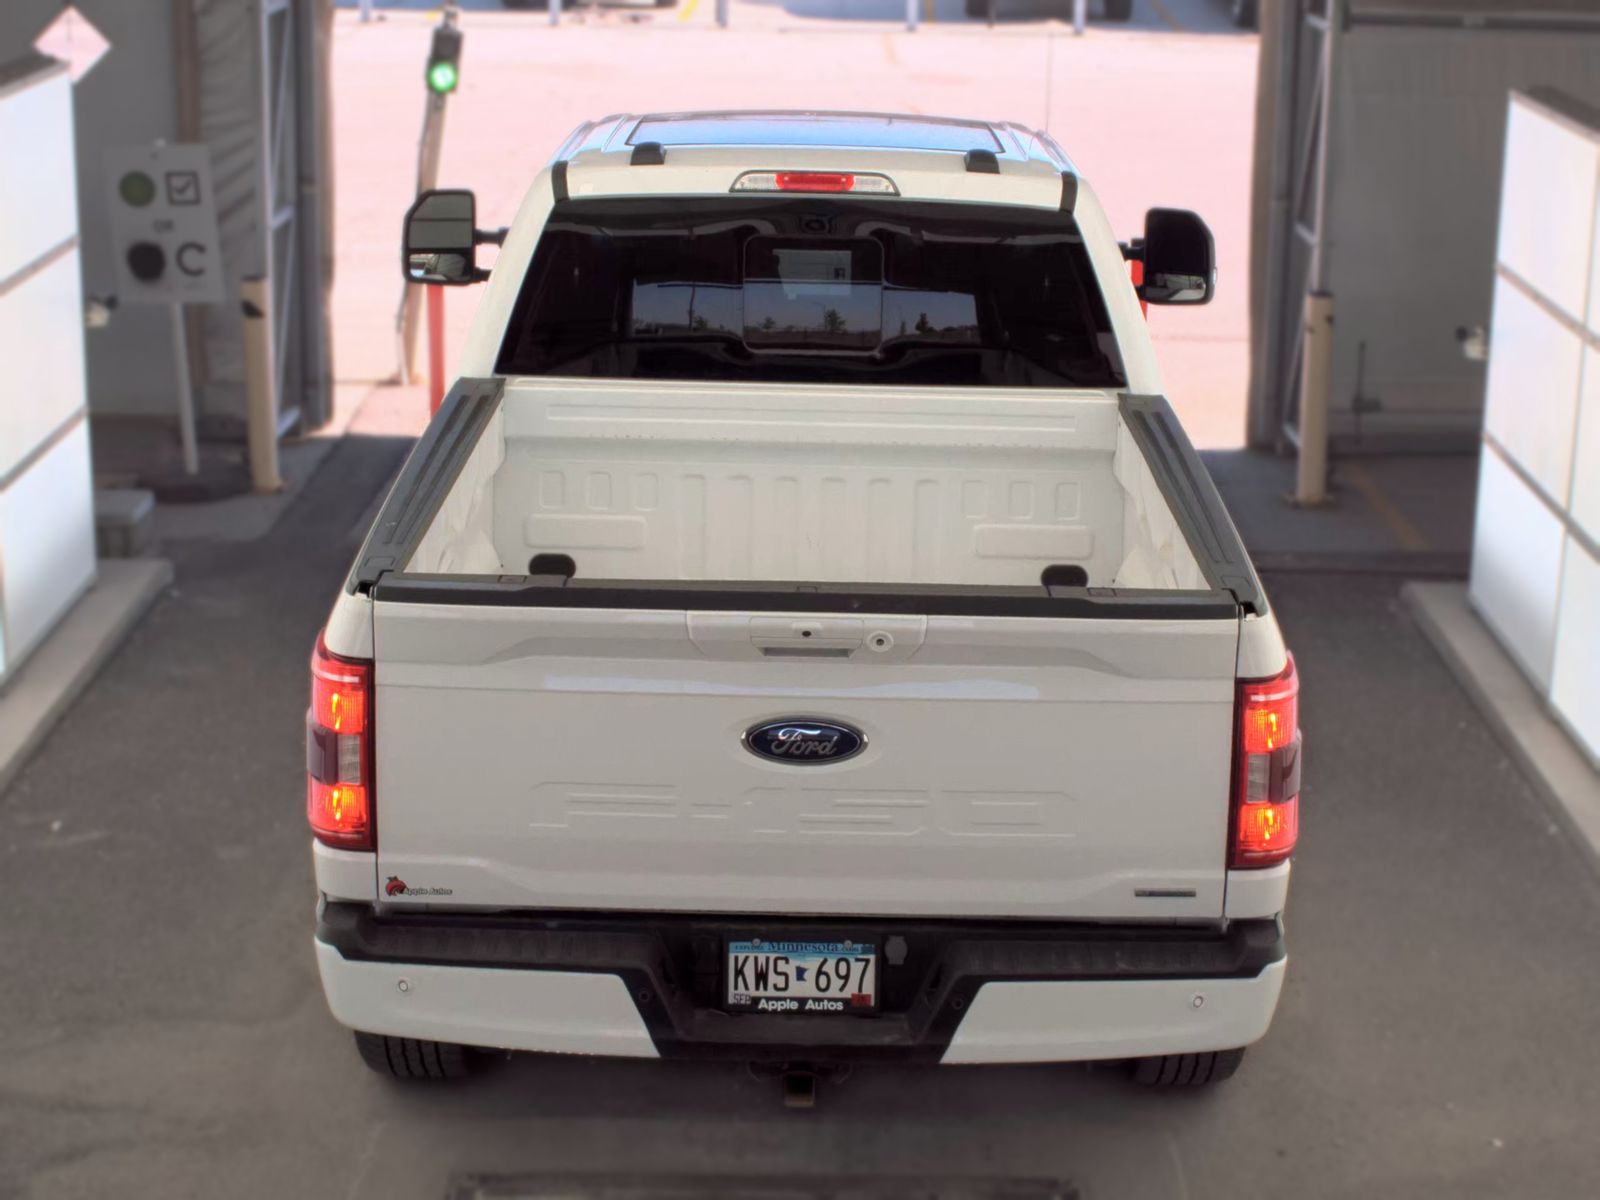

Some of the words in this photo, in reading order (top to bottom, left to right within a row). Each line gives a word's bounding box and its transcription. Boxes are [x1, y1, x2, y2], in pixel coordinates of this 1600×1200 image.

[175, 241, 206, 277] C
[771, 727, 838, 755] Ford
[768, 942, 838, 953] Minnesota
[733, 955, 790, 992] KWS
[815, 957, 871, 994] 697
[758, 998, 799, 1011] Apple
[805, 999, 843, 1010] Autos
